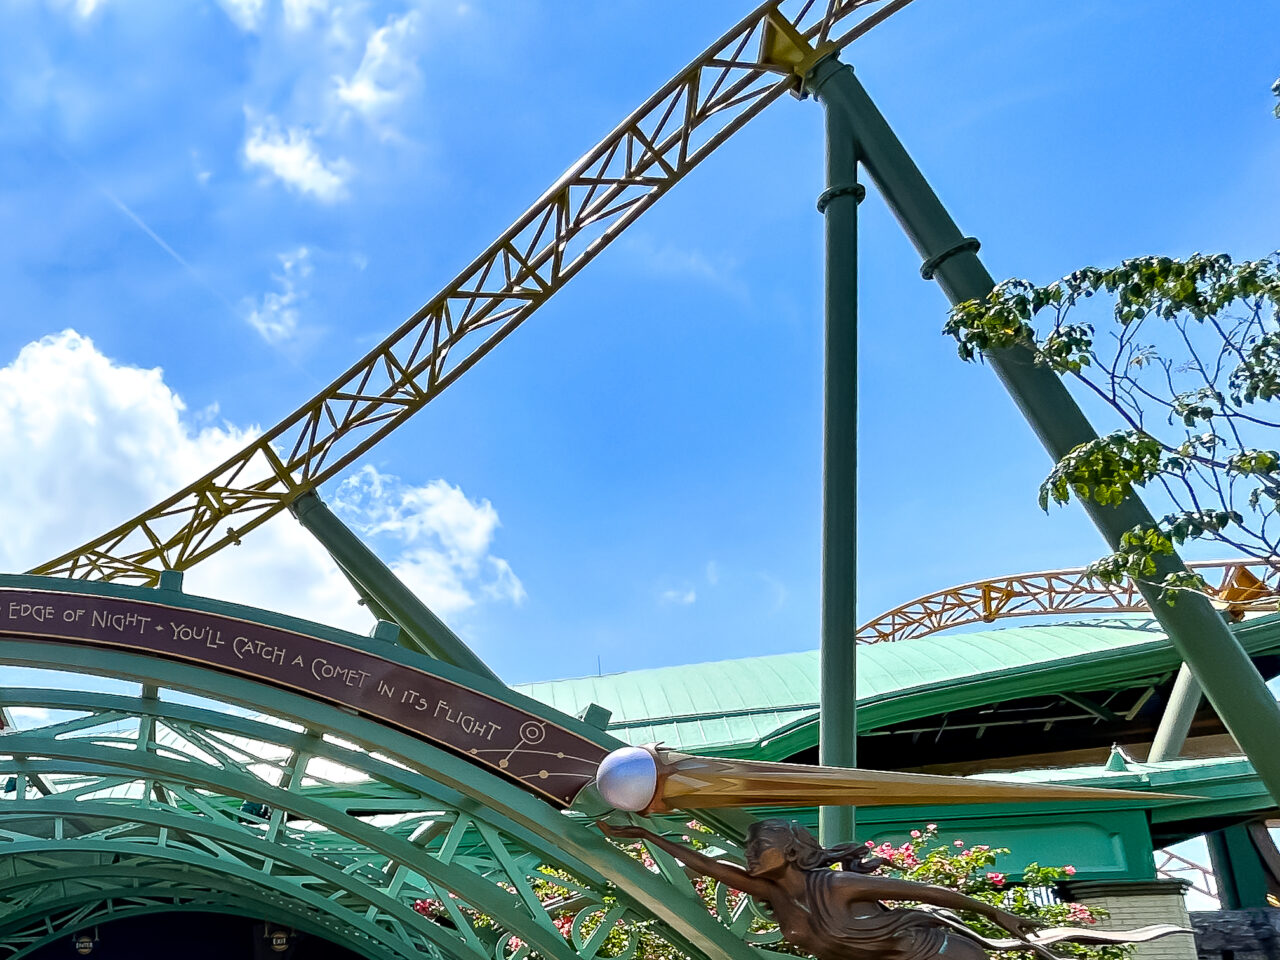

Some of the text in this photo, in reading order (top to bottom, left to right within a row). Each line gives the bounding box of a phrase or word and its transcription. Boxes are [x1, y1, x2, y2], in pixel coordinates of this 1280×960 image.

[9, 602, 55, 621] EDGE
[63, 610, 86, 622] OF
[91, 611, 151, 634] NIGHT
[170, 623, 225, 648] YOU'LL
[233, 637, 286, 665] CATCH
[292, 656, 304, 667] A
[311, 658, 371, 690] COMET
[378, 681, 394, 698] IN
[401, 690, 428, 711] ITS
[434, 701, 501, 741] FLIGHT
